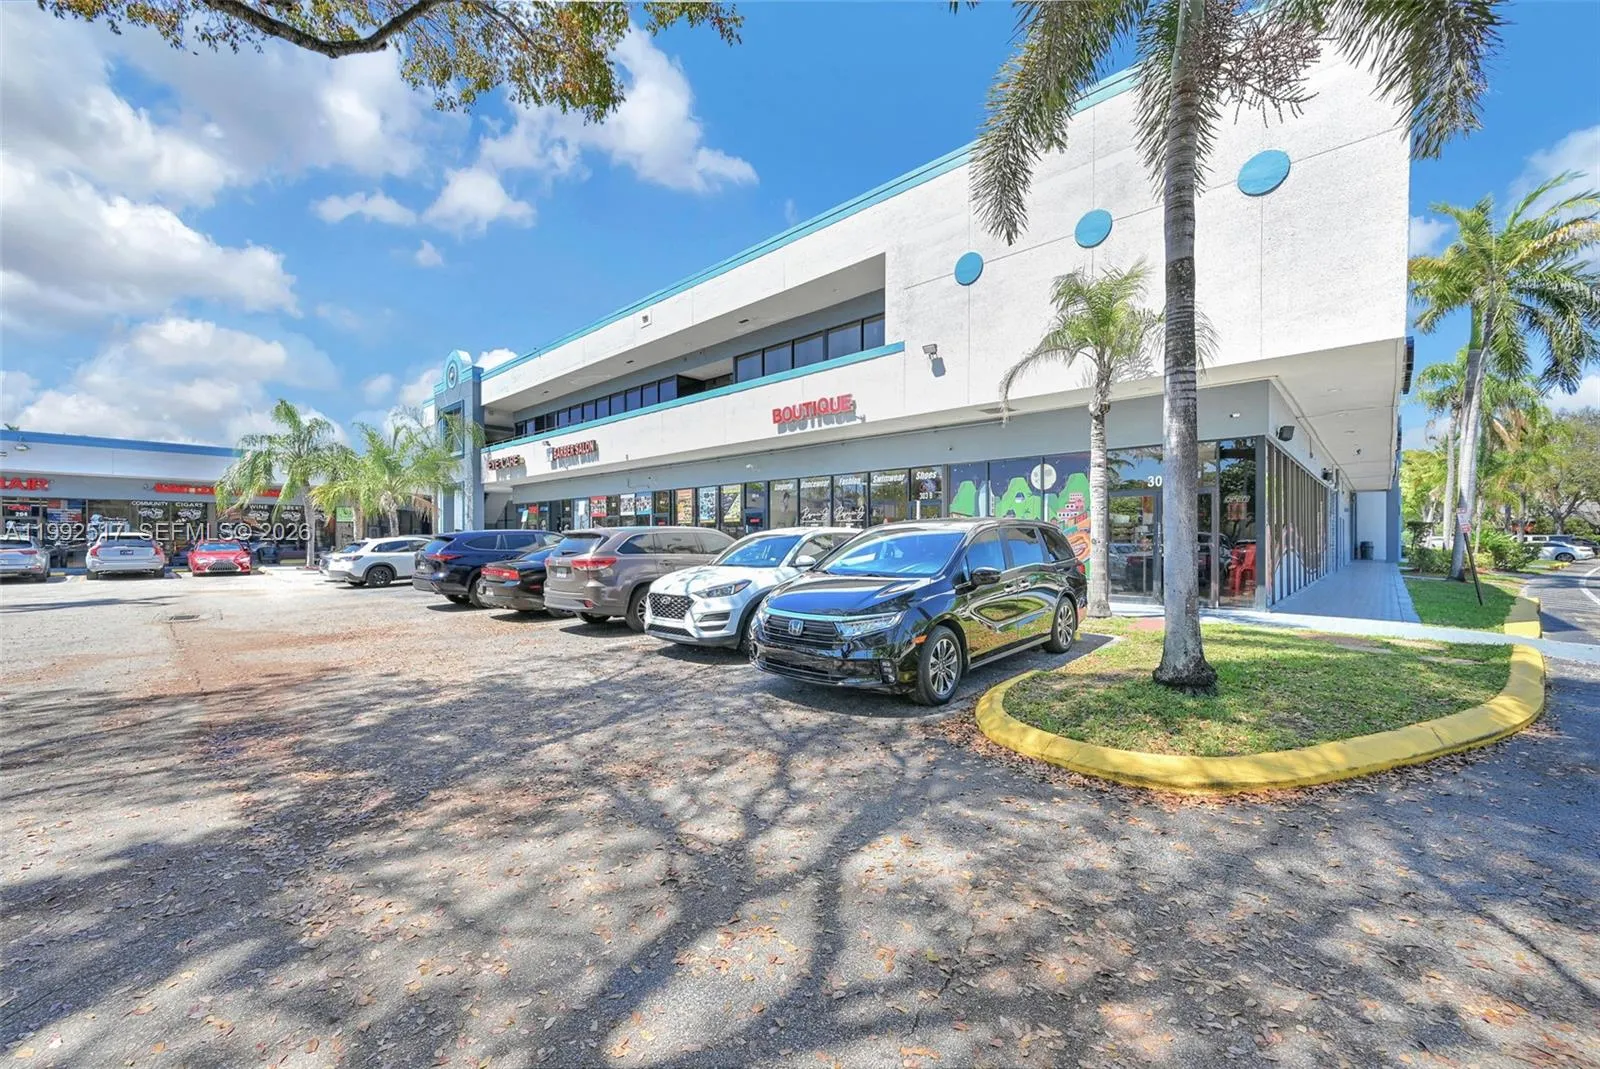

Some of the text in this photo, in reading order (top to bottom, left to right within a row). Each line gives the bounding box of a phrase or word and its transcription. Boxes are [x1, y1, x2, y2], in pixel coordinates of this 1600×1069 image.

[772, 394, 854, 424] BOUTIQUE
[575, 440, 596, 457] SALON
[839, 476, 861, 486] Fashion
[873, 473, 905, 484] Swimwear
[915, 471, 937, 481] Shoes
